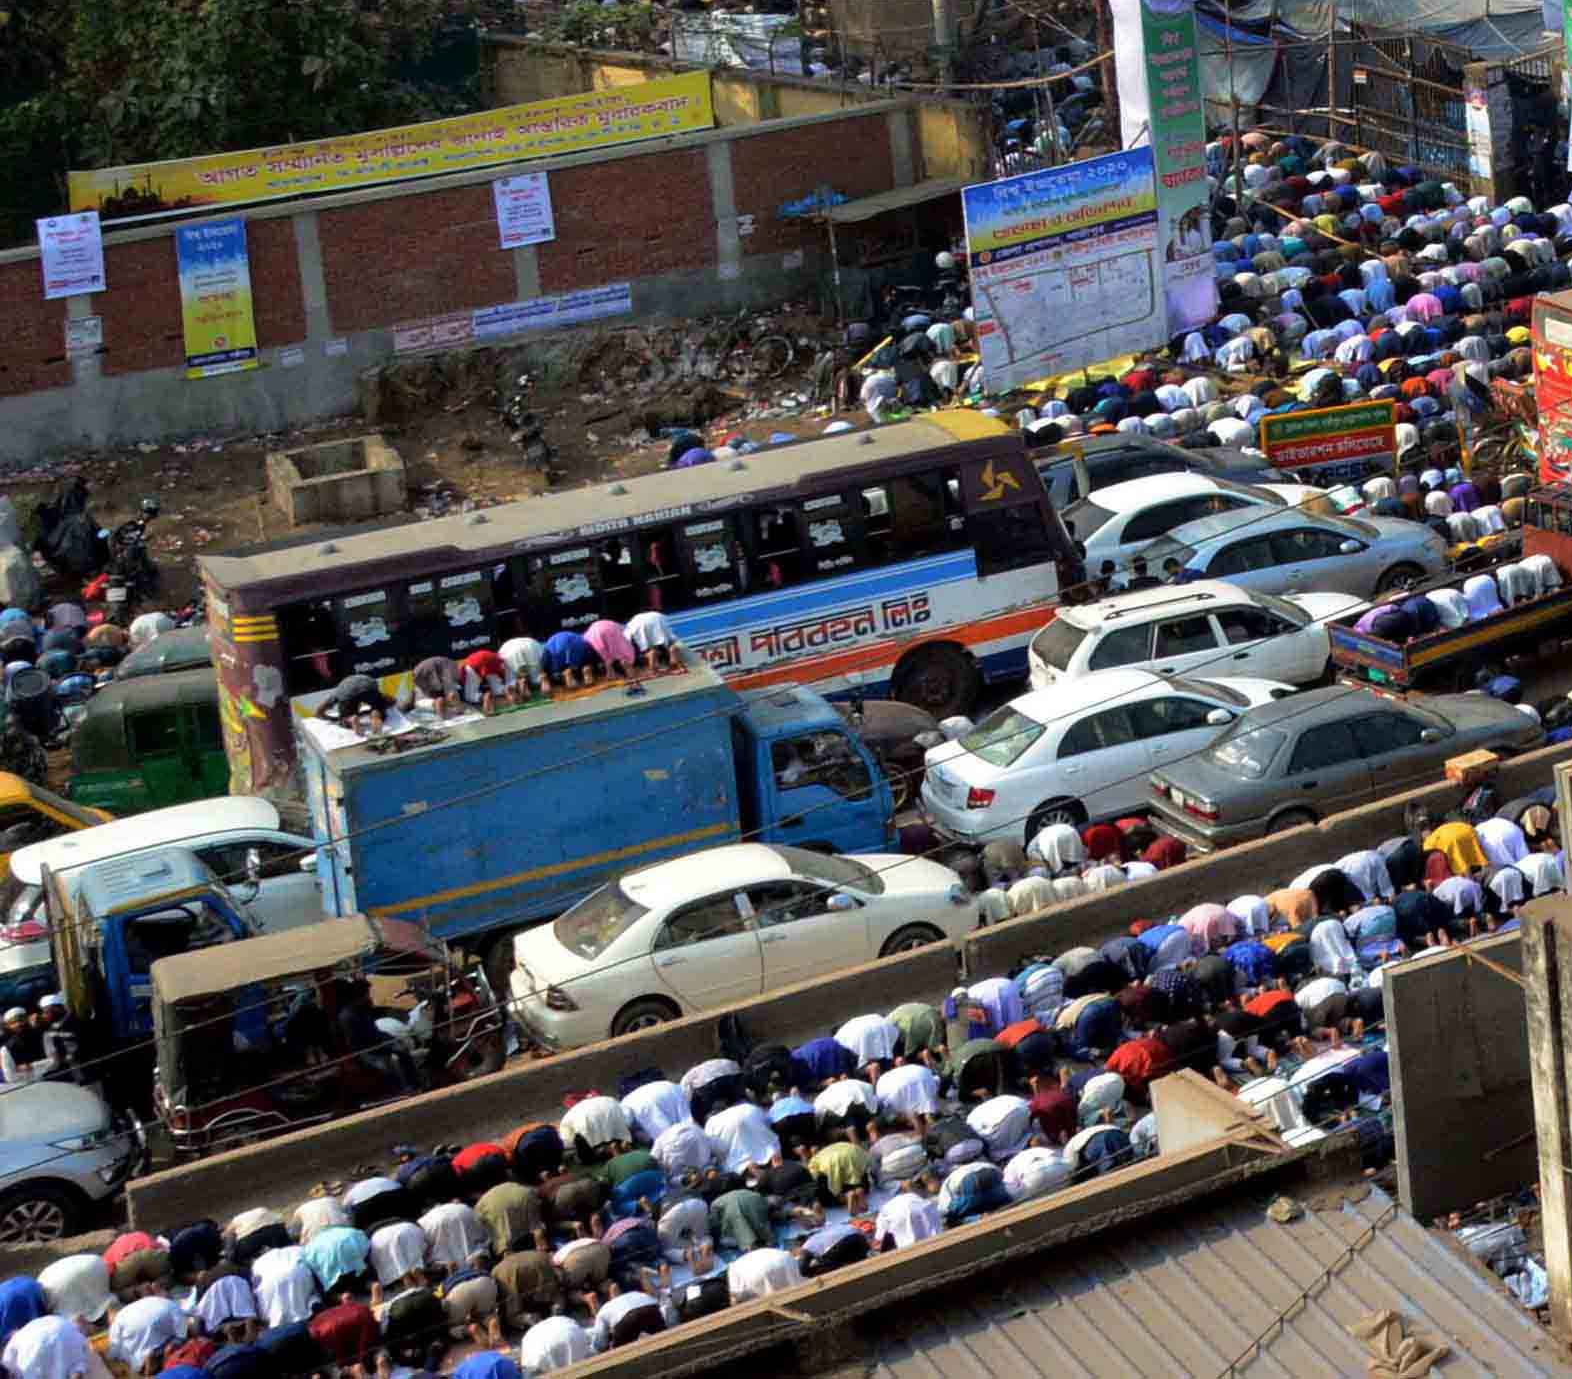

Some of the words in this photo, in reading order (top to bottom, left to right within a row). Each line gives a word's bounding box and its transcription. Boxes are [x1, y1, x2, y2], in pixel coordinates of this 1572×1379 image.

[199, 164, 257, 186] আগত
[993, 184, 1018, 199] বিশ্ব
[1023, 168, 1082, 192] ইজতেমা
[1087, 159, 1127, 176] ২০২০
[750, 605, 875, 657] পরিবহন
[881, 591, 931, 630] লিঃ
